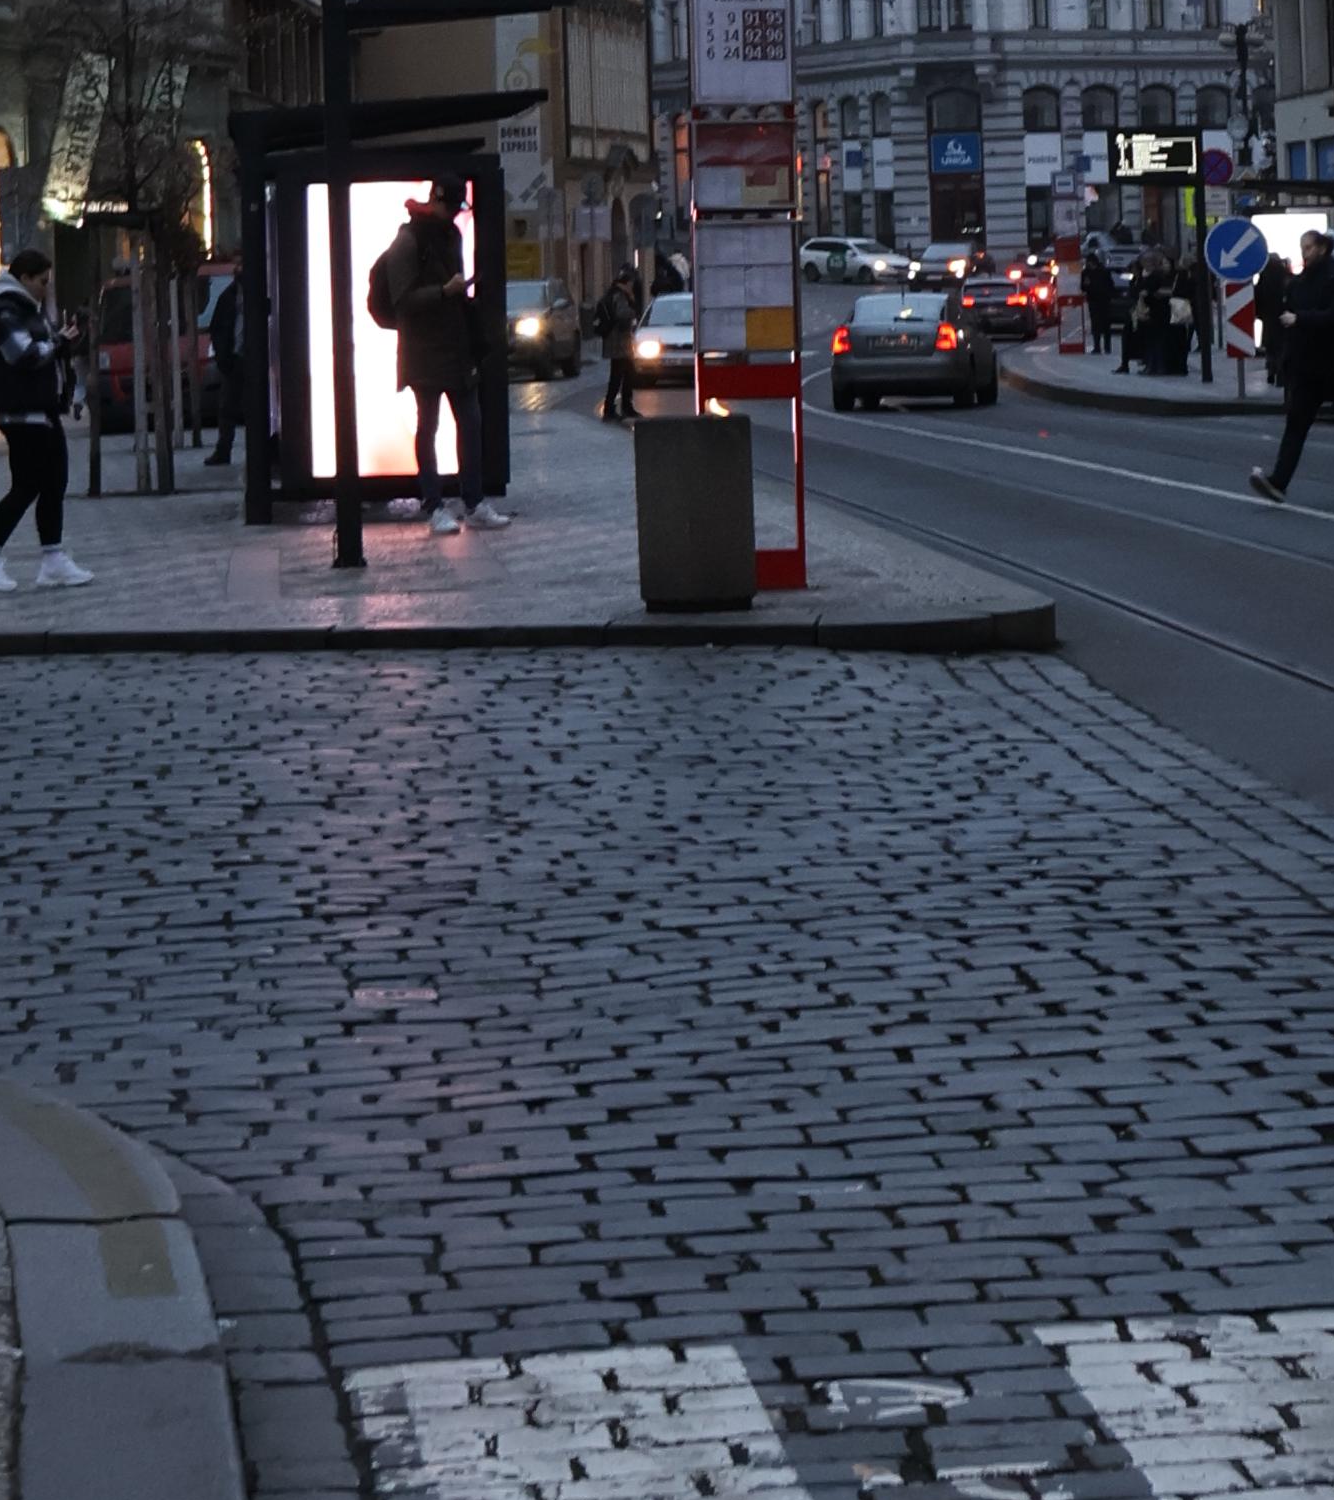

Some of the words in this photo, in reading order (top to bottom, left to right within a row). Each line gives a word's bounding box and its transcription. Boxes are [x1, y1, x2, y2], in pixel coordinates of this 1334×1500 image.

[706, 11, 715, 25] 3
[726, 11, 736, 26] 9
[744, 11, 760, 26] 91
[706, 28, 715, 43] 5
[723, 28, 740, 43] 14
[745, 28, 763, 44] 92
[765, 28, 784, 43] 96
[706, 46, 715, 61] 6
[723, 46, 740, 61] 24
[745, 45, 763, 61] 94
[765, 45, 784, 60] 98
